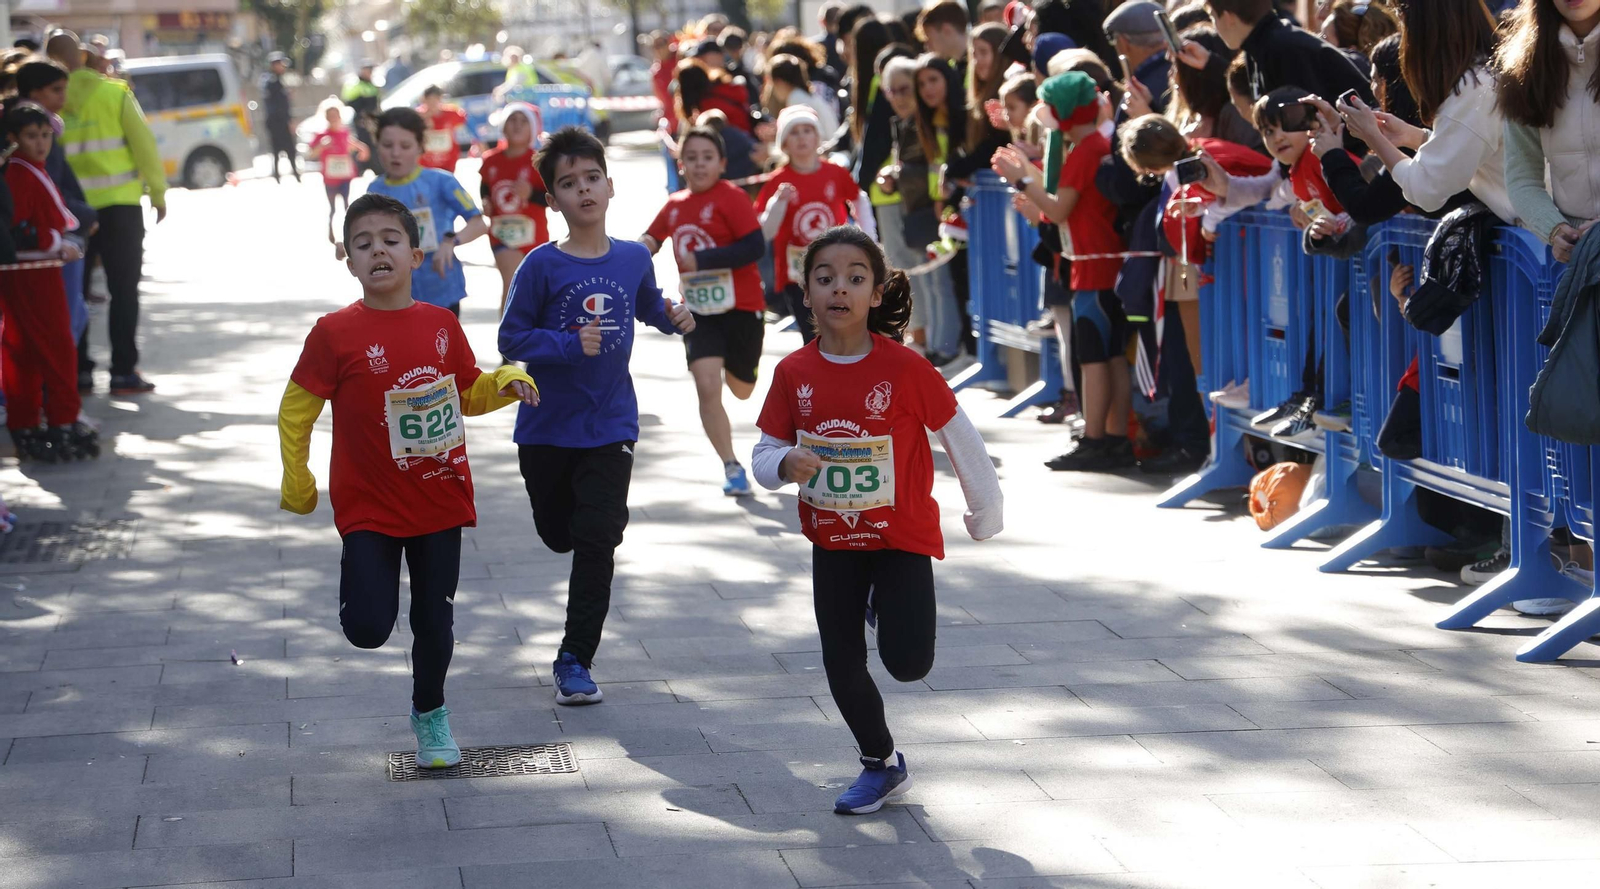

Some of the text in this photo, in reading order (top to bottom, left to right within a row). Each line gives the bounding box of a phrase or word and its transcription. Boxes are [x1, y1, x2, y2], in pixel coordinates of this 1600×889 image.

[684, 285, 726, 304] 680
[576, 316, 616, 325] Chpion
[369, 357, 388, 367] UCA
[398, 366, 437, 386] SOLIDARIA
[798, 399, 812, 407] UCA
[399, 402, 457, 440] 622
[815, 419, 861, 434] SOLIDARIA
[841, 447, 872, 458] NAVIDAD
[829, 533, 881, 542] CUPRA
